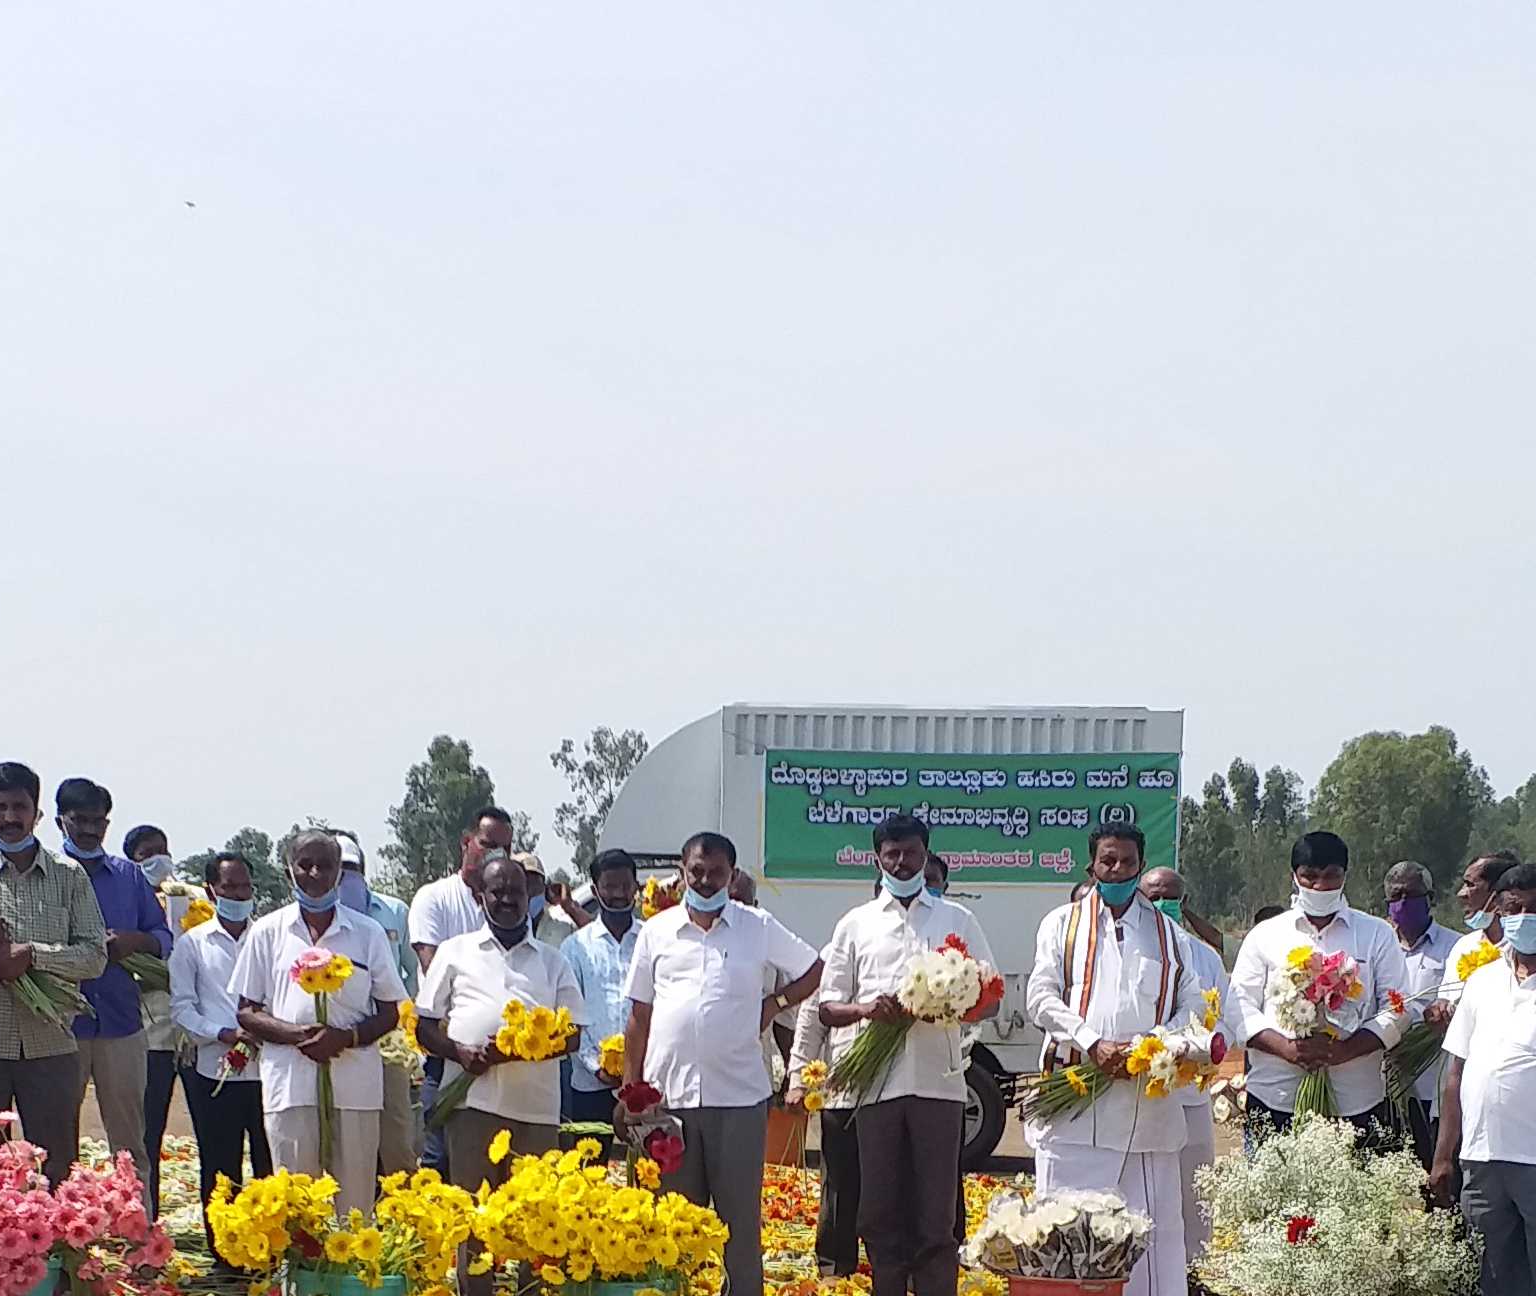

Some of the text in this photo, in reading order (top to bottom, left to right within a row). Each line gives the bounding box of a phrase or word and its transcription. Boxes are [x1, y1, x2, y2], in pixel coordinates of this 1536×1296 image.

[771, 761, 1175, 795] ದೊಡ್ಡಬಳ್ಳಾಪುರ ತಾಲ್ಲೂಕು ಹಸಿರು ಮನೆ ಹೂ
[1040, 807, 1089, 828] ಸಂಘ
